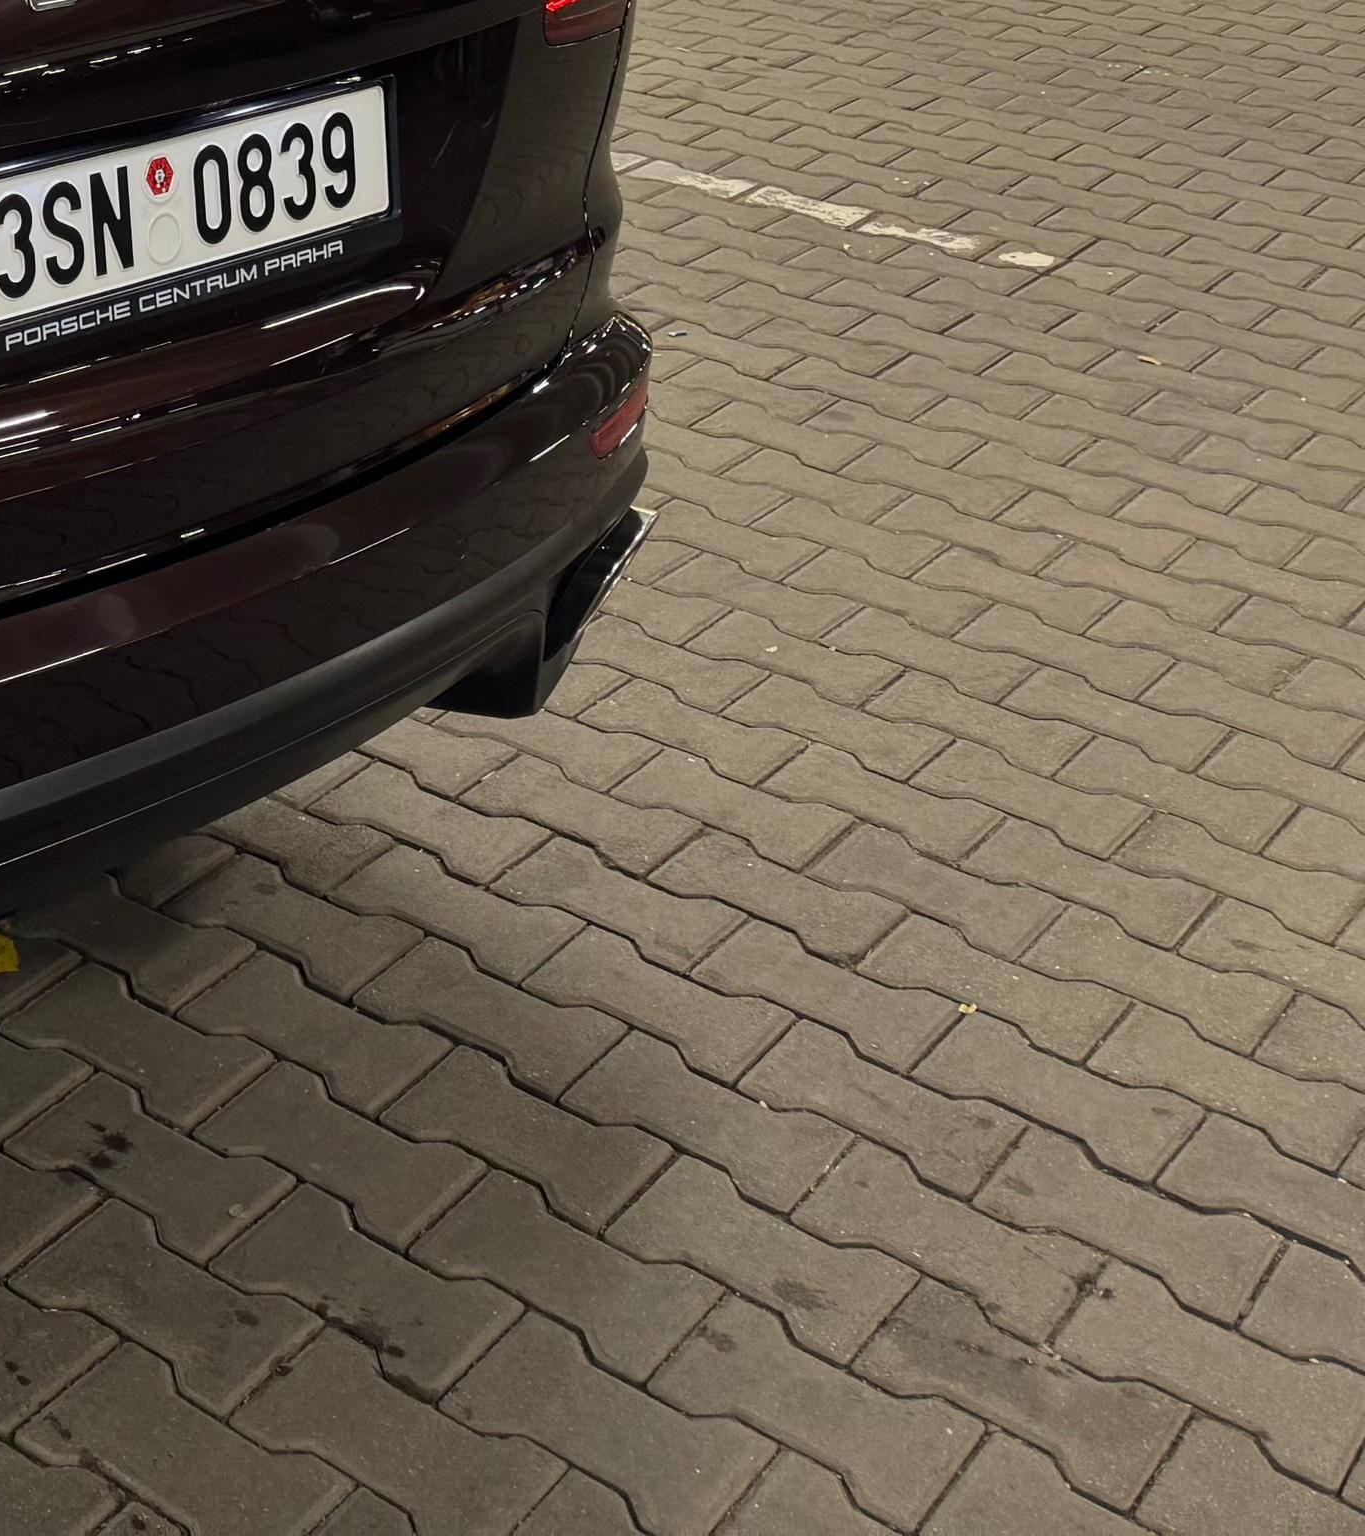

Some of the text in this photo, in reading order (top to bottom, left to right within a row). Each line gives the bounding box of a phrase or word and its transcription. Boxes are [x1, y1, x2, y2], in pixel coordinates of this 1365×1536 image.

[192, 111, 356, 246] 0839
[5, 240, 344, 352] PORSCHE CENTRUM PRAHA
